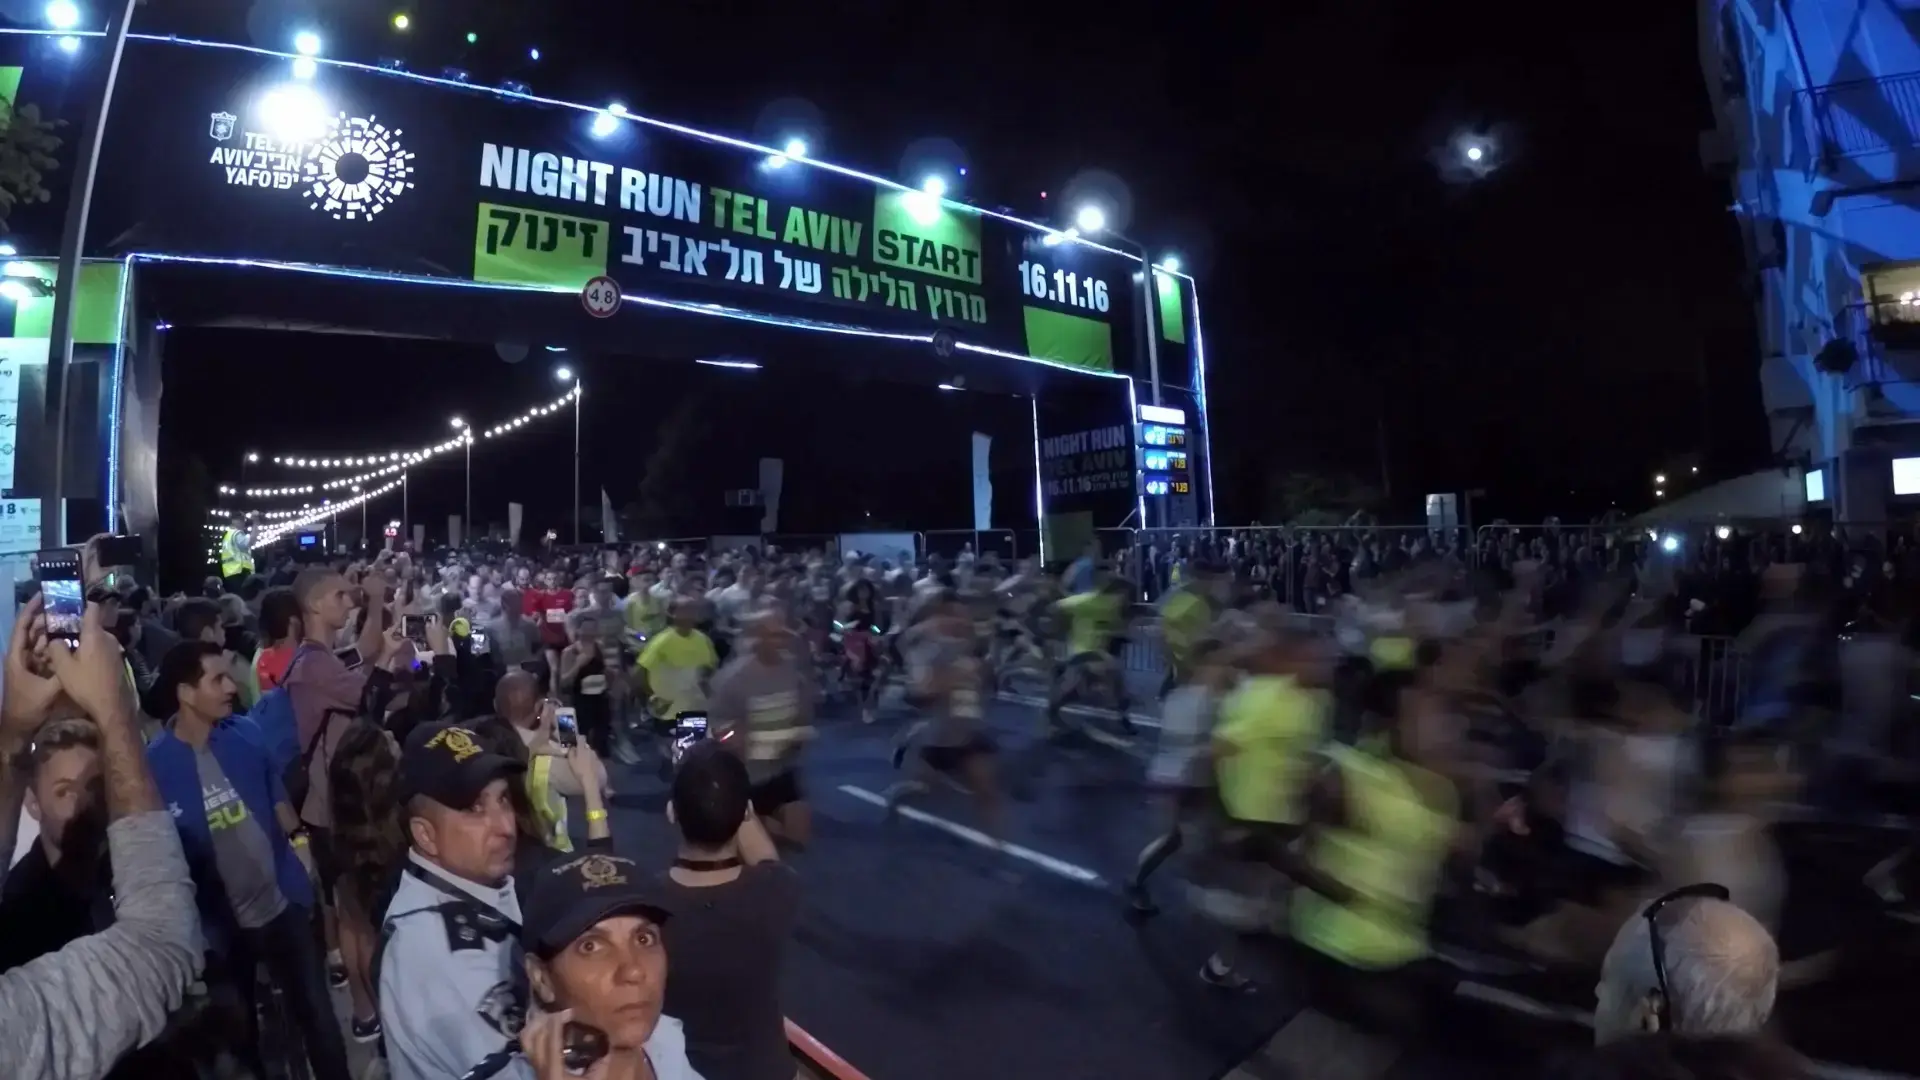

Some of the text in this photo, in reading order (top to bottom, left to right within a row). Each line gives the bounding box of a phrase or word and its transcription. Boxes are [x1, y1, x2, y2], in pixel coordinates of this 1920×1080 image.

[210, 146, 255, 167] AVIV
[253, 150, 302, 173] אביב
[225, 166, 272, 188] YAFO
[272, 171, 300, 190] יפו
[479, 142, 863, 257] NIGHT RUN TEL AVIV
[486, 208, 599, 258] זינוק
[774, 249, 822, 294] של
[877, 229, 979, 278] START
[831, 265, 917, 311] הלילה
[925, 284, 987, 324] מרוץ
[1018, 260, 1110, 313] 16.11.16
[1043, 431, 1089, 460] NIGHT
[1091, 424, 1126, 452] RUN
[1082, 450, 1127, 473] AVIV
